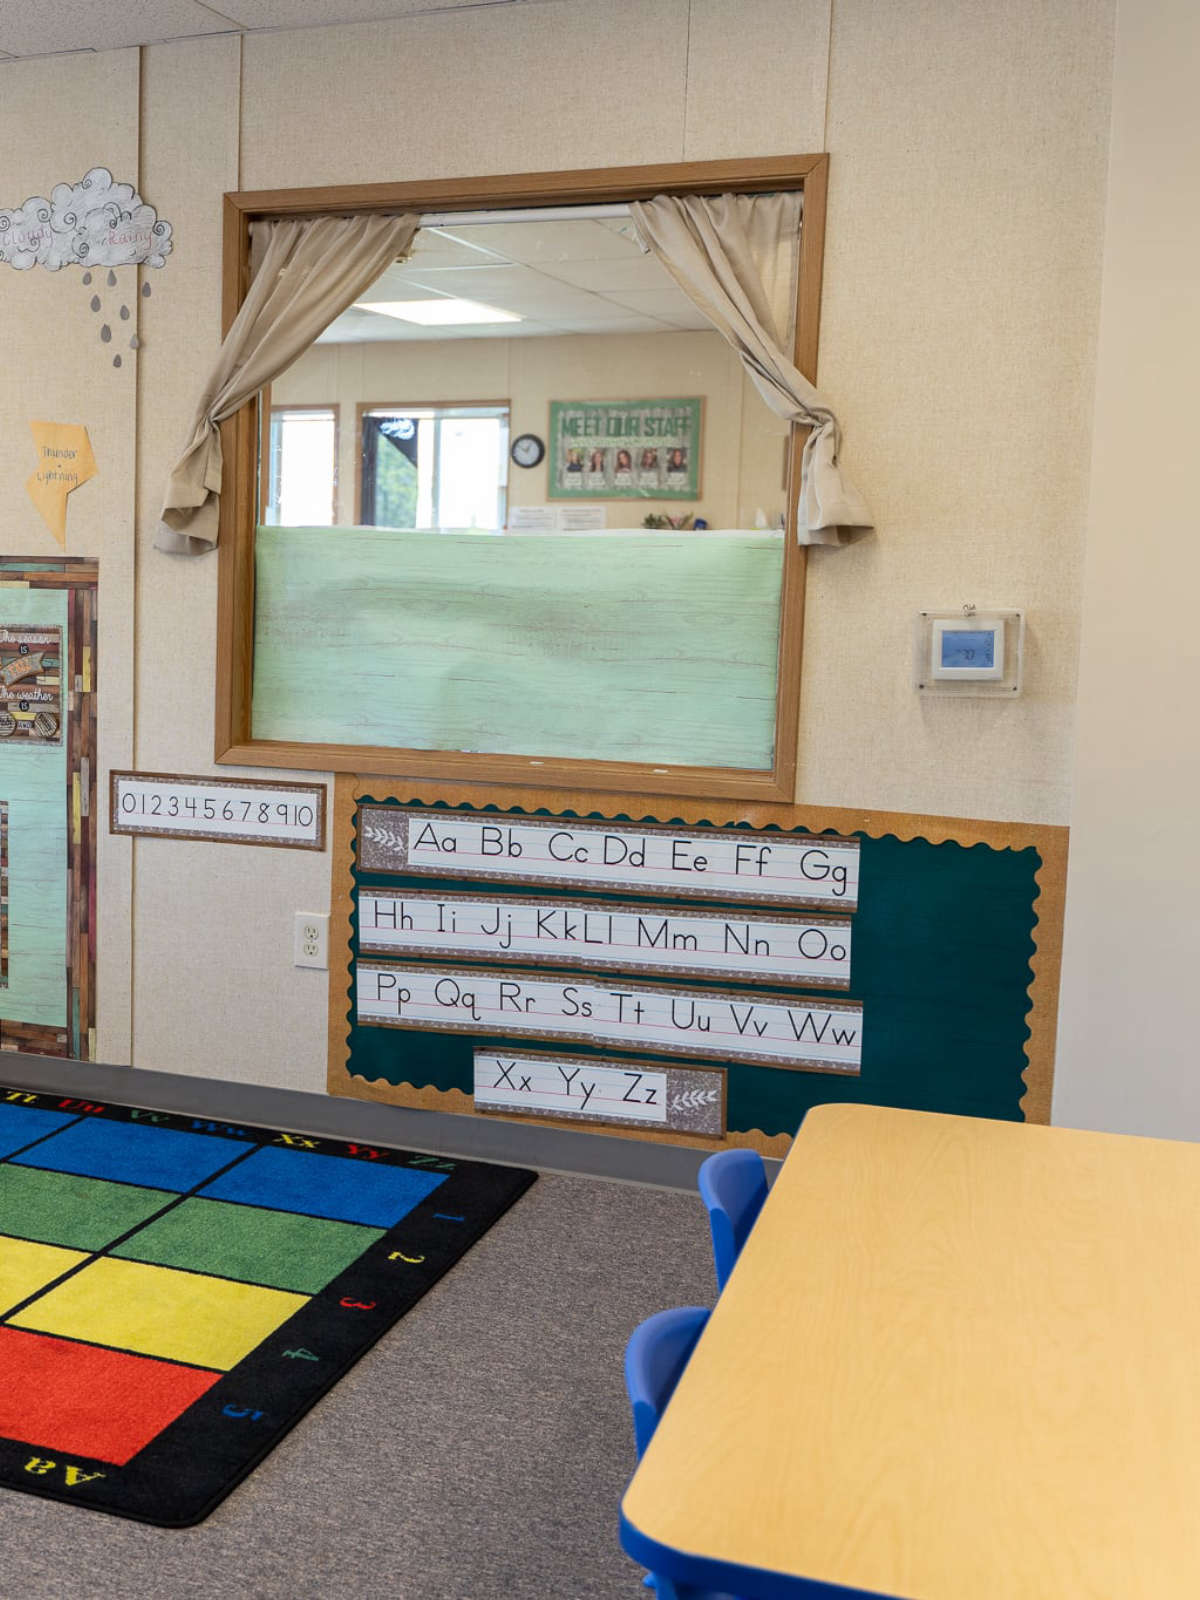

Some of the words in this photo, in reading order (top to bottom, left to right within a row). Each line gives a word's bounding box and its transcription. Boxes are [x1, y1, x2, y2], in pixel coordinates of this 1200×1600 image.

[108, 231, 151, 249] Rainy
[561, 415, 601, 437] MEET
[607, 416, 640, 437] OUR
[644, 415, 689, 437] STAFF
[413, 822, 457, 853] Aa
[481, 826, 523, 858] Bb
[548, 832, 589, 863] Cc
[603, 835, 646, 868] Dd
[671, 839, 709, 872] Ee
[735, 844, 772, 877] Ff
[800, 849, 847, 897] Gg
[374, 900, 413, 930] Hh
[437, 903, 456, 933] Ii
[480, 907, 512, 949] Jj
[638, 917, 697, 951] Mm
[725, 923, 770, 956] Nn
[798, 928, 847, 961] Oo
[377, 973, 411, 1015] Pp
[434, 978, 482, 1021] Qq
[500, 982, 536, 1013] Rr
[561, 987, 593, 1017] Ss
[610, 993, 645, 1024] Tt
[671, 999, 710, 1033] Uu
[729, 1004, 768, 1037] Vv
[787, 1009, 856, 1047] Ww
[493, 1060, 532, 1092] Xx
[557, 1066, 596, 1110] Yy
[623, 1073, 657, 1105] Zz
